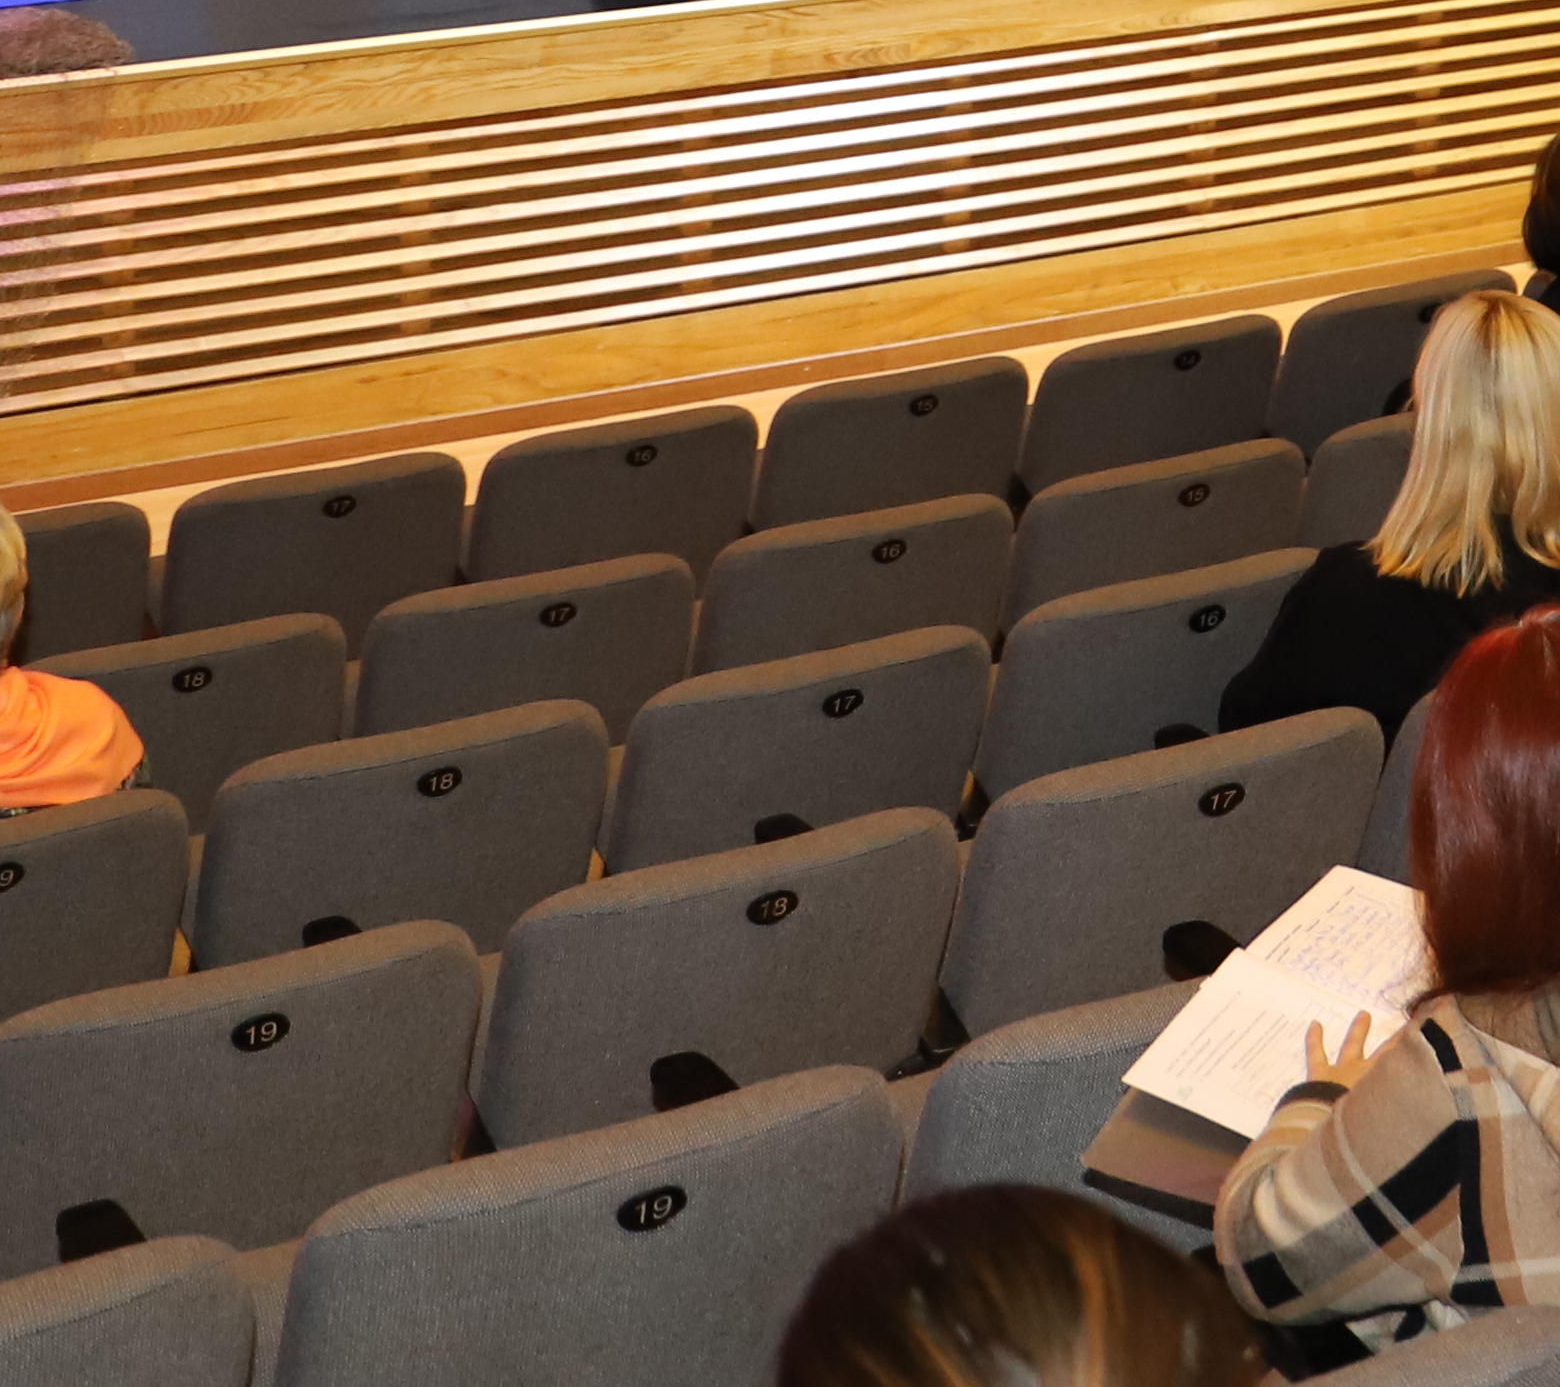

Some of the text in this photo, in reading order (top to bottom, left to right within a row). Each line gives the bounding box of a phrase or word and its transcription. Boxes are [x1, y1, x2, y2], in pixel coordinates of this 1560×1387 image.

[1186, 487, 1204, 503] 15
[333, 499, 352, 514] 17
[880, 544, 901, 559] 16
[548, 608, 570, 623] 17
[1199, 610, 1219, 627] 16
[182, 672, 205, 688] 18
[833, 694, 856, 713] 17
[428, 772, 454, 792] 18
[1210, 789, 1237, 810] 17
[760, 897, 788, 919] 18
[246, 1021, 278, 1046] 19
[637, 1194, 673, 1225] 19
